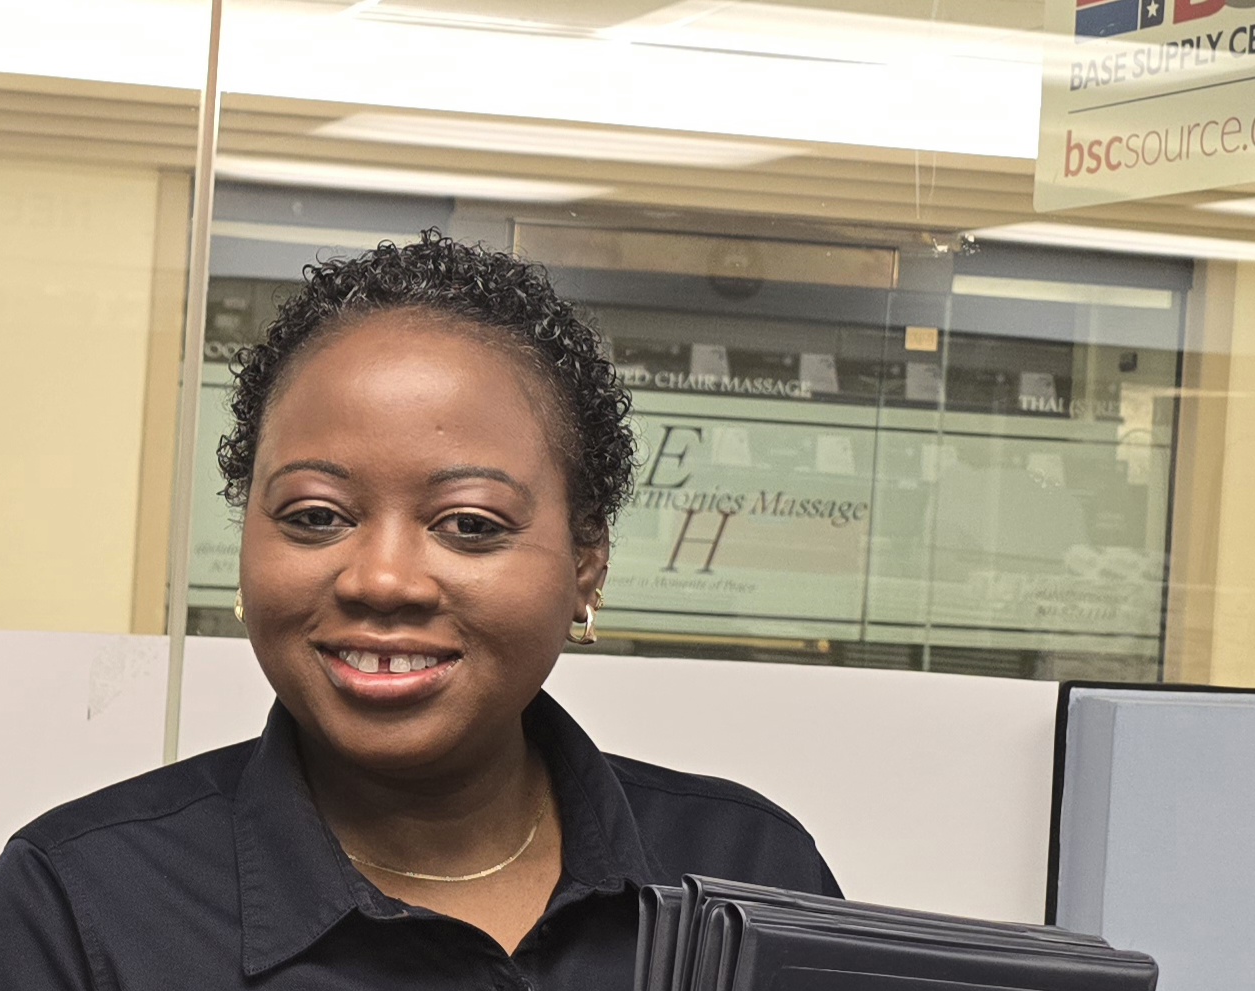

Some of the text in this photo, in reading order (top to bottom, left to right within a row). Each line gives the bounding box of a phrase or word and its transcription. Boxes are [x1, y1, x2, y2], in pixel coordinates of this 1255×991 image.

[1069, 53, 1127, 91] BASE
[1131, 31, 1224, 79] SUPPLY
[1064, 116, 1255, 178] bscsource.
[654, 371, 718, 390] CHAIR
[720, 374, 812, 398] MASSAGE
[1019, 396, 1065, 414] THAI
[640, 425, 702, 489] E
[748, 490, 869, 528] Massage
[661, 509, 737, 574] H
